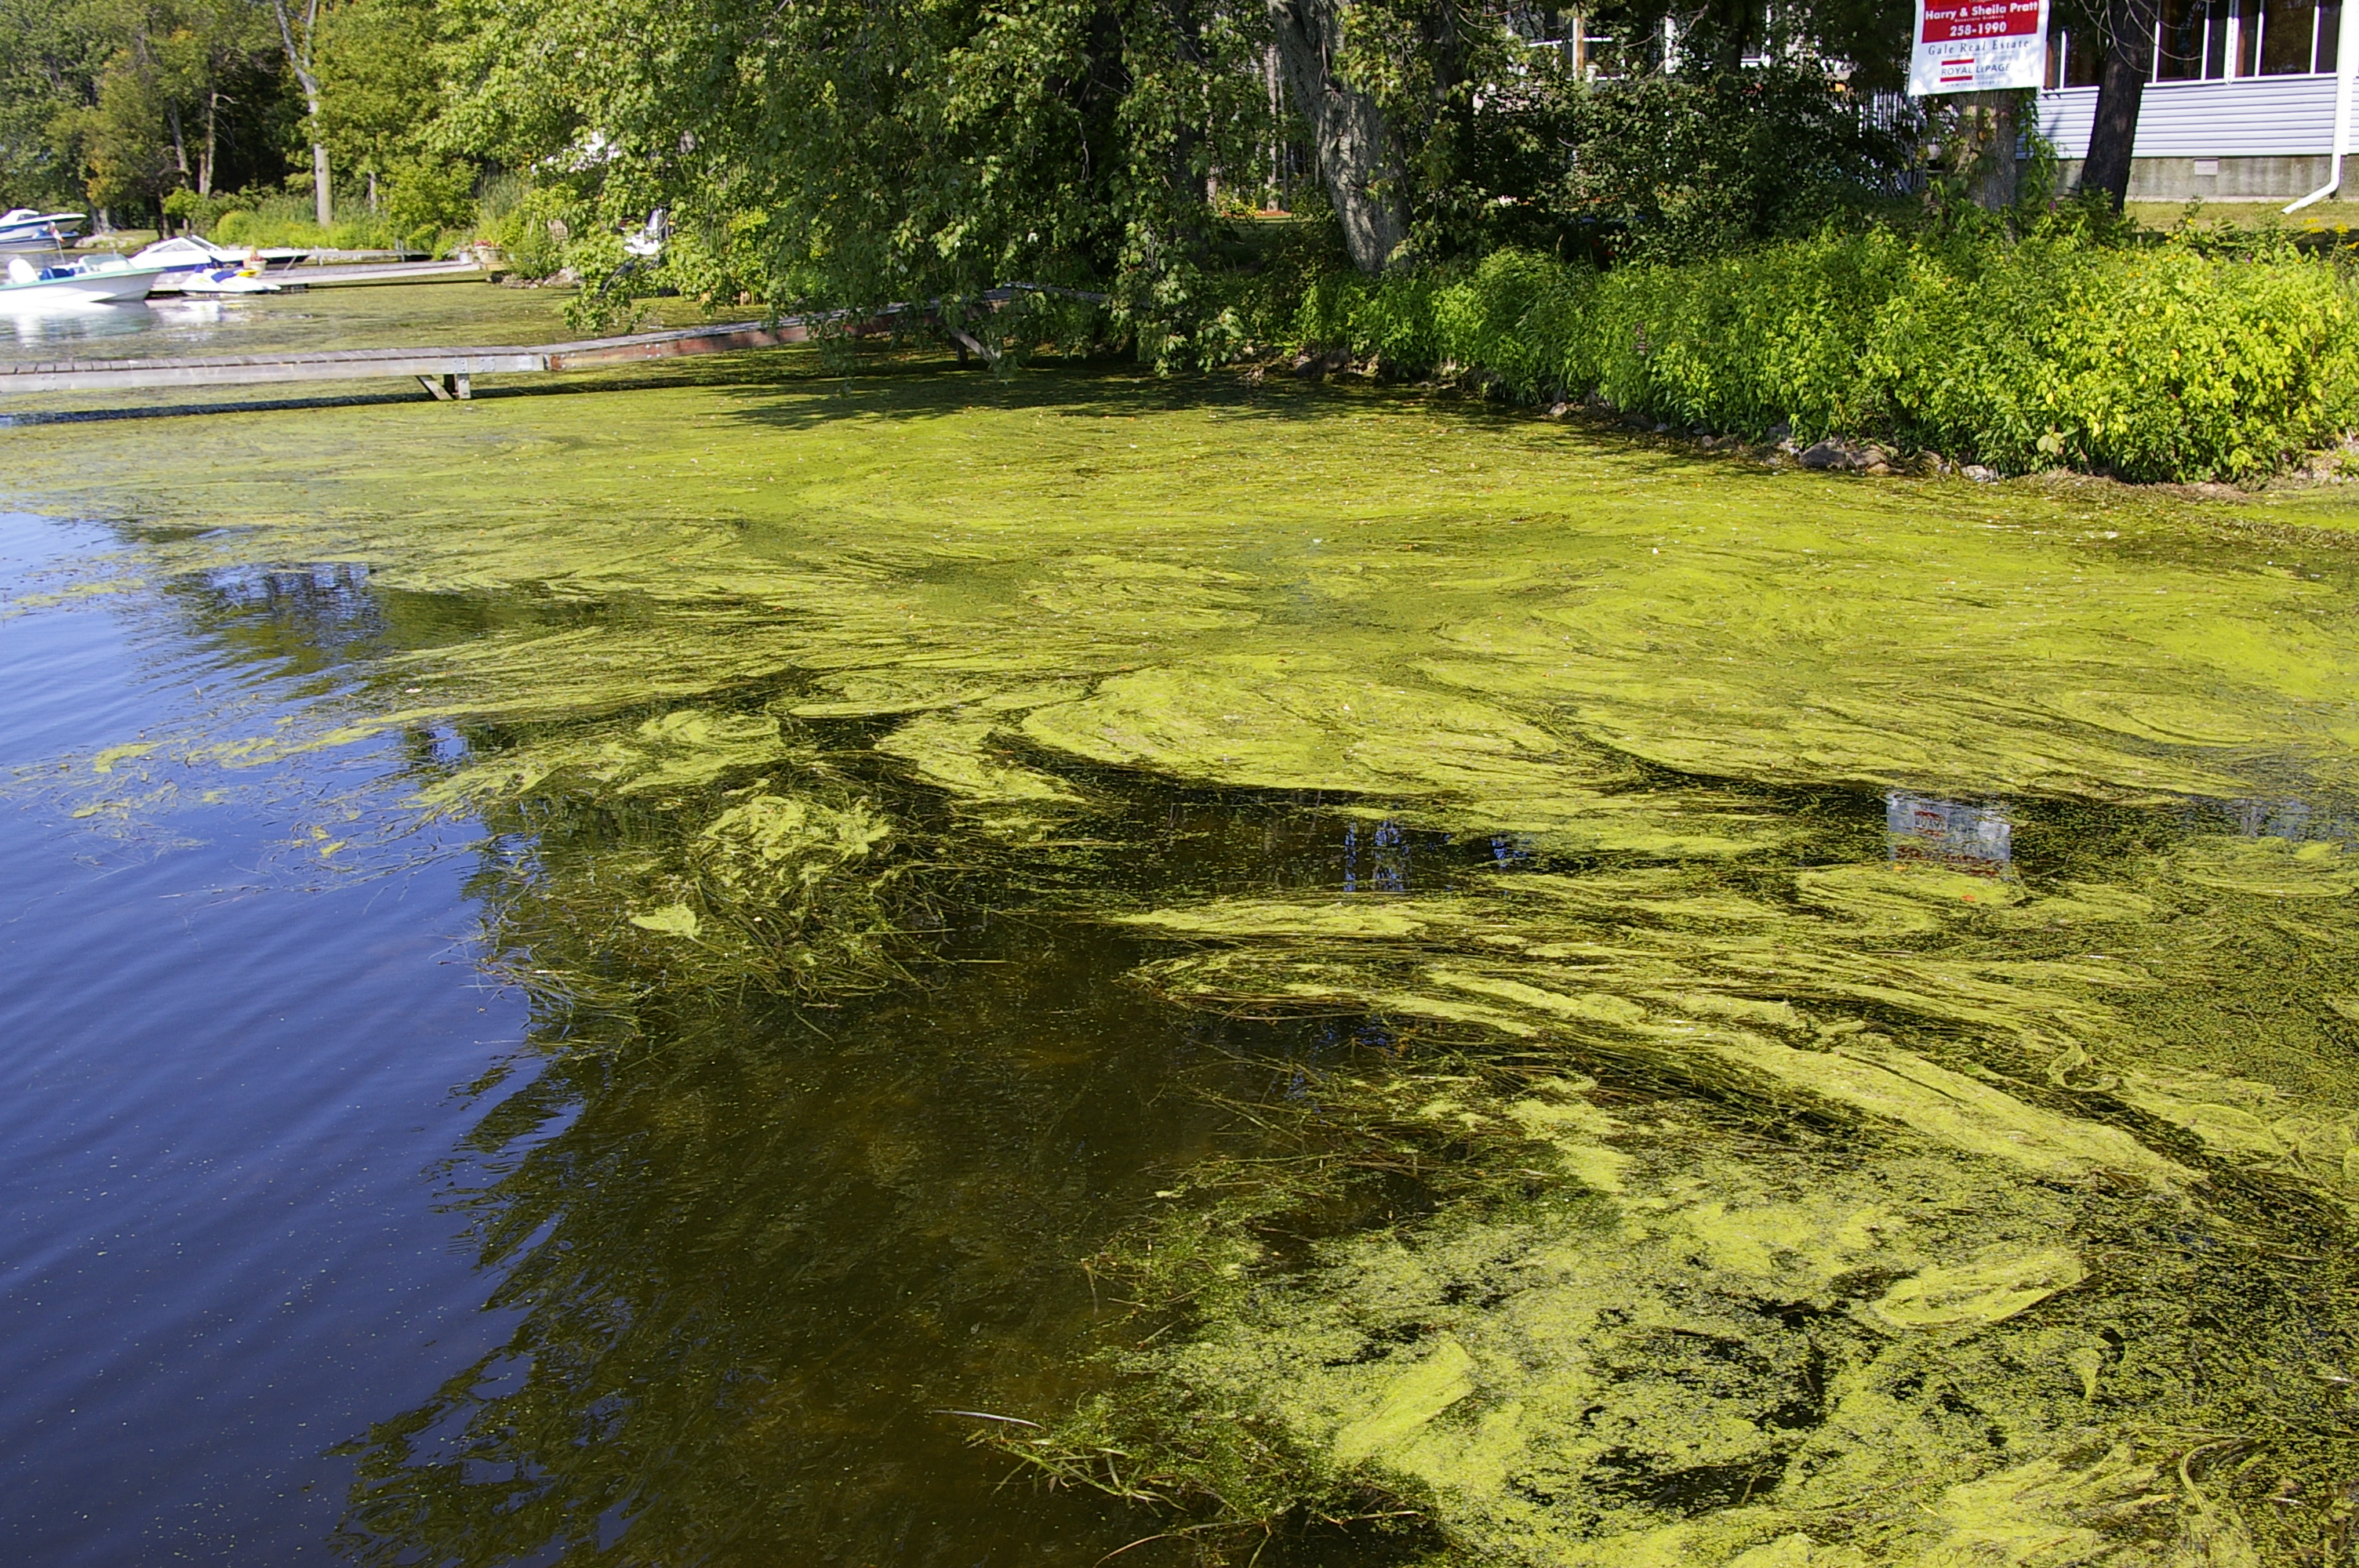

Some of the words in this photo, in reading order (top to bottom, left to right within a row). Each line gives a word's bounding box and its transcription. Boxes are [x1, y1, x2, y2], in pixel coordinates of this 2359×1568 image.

[1925, 10, 1957, 20] Harry
[1959, 7, 1968, 17] &
[1971, 3, 2007, 16] Sheila
[2009, 2, 2038, 13] Pratt
[1950, 22, 2007, 37] 258-1990
[1928, 44, 1954, 56] Gale
[1960, 41, 1986, 53] Real
[1992, 40, 2030, 50] Estate
[1941, 67, 1972, 76] ROYAL
